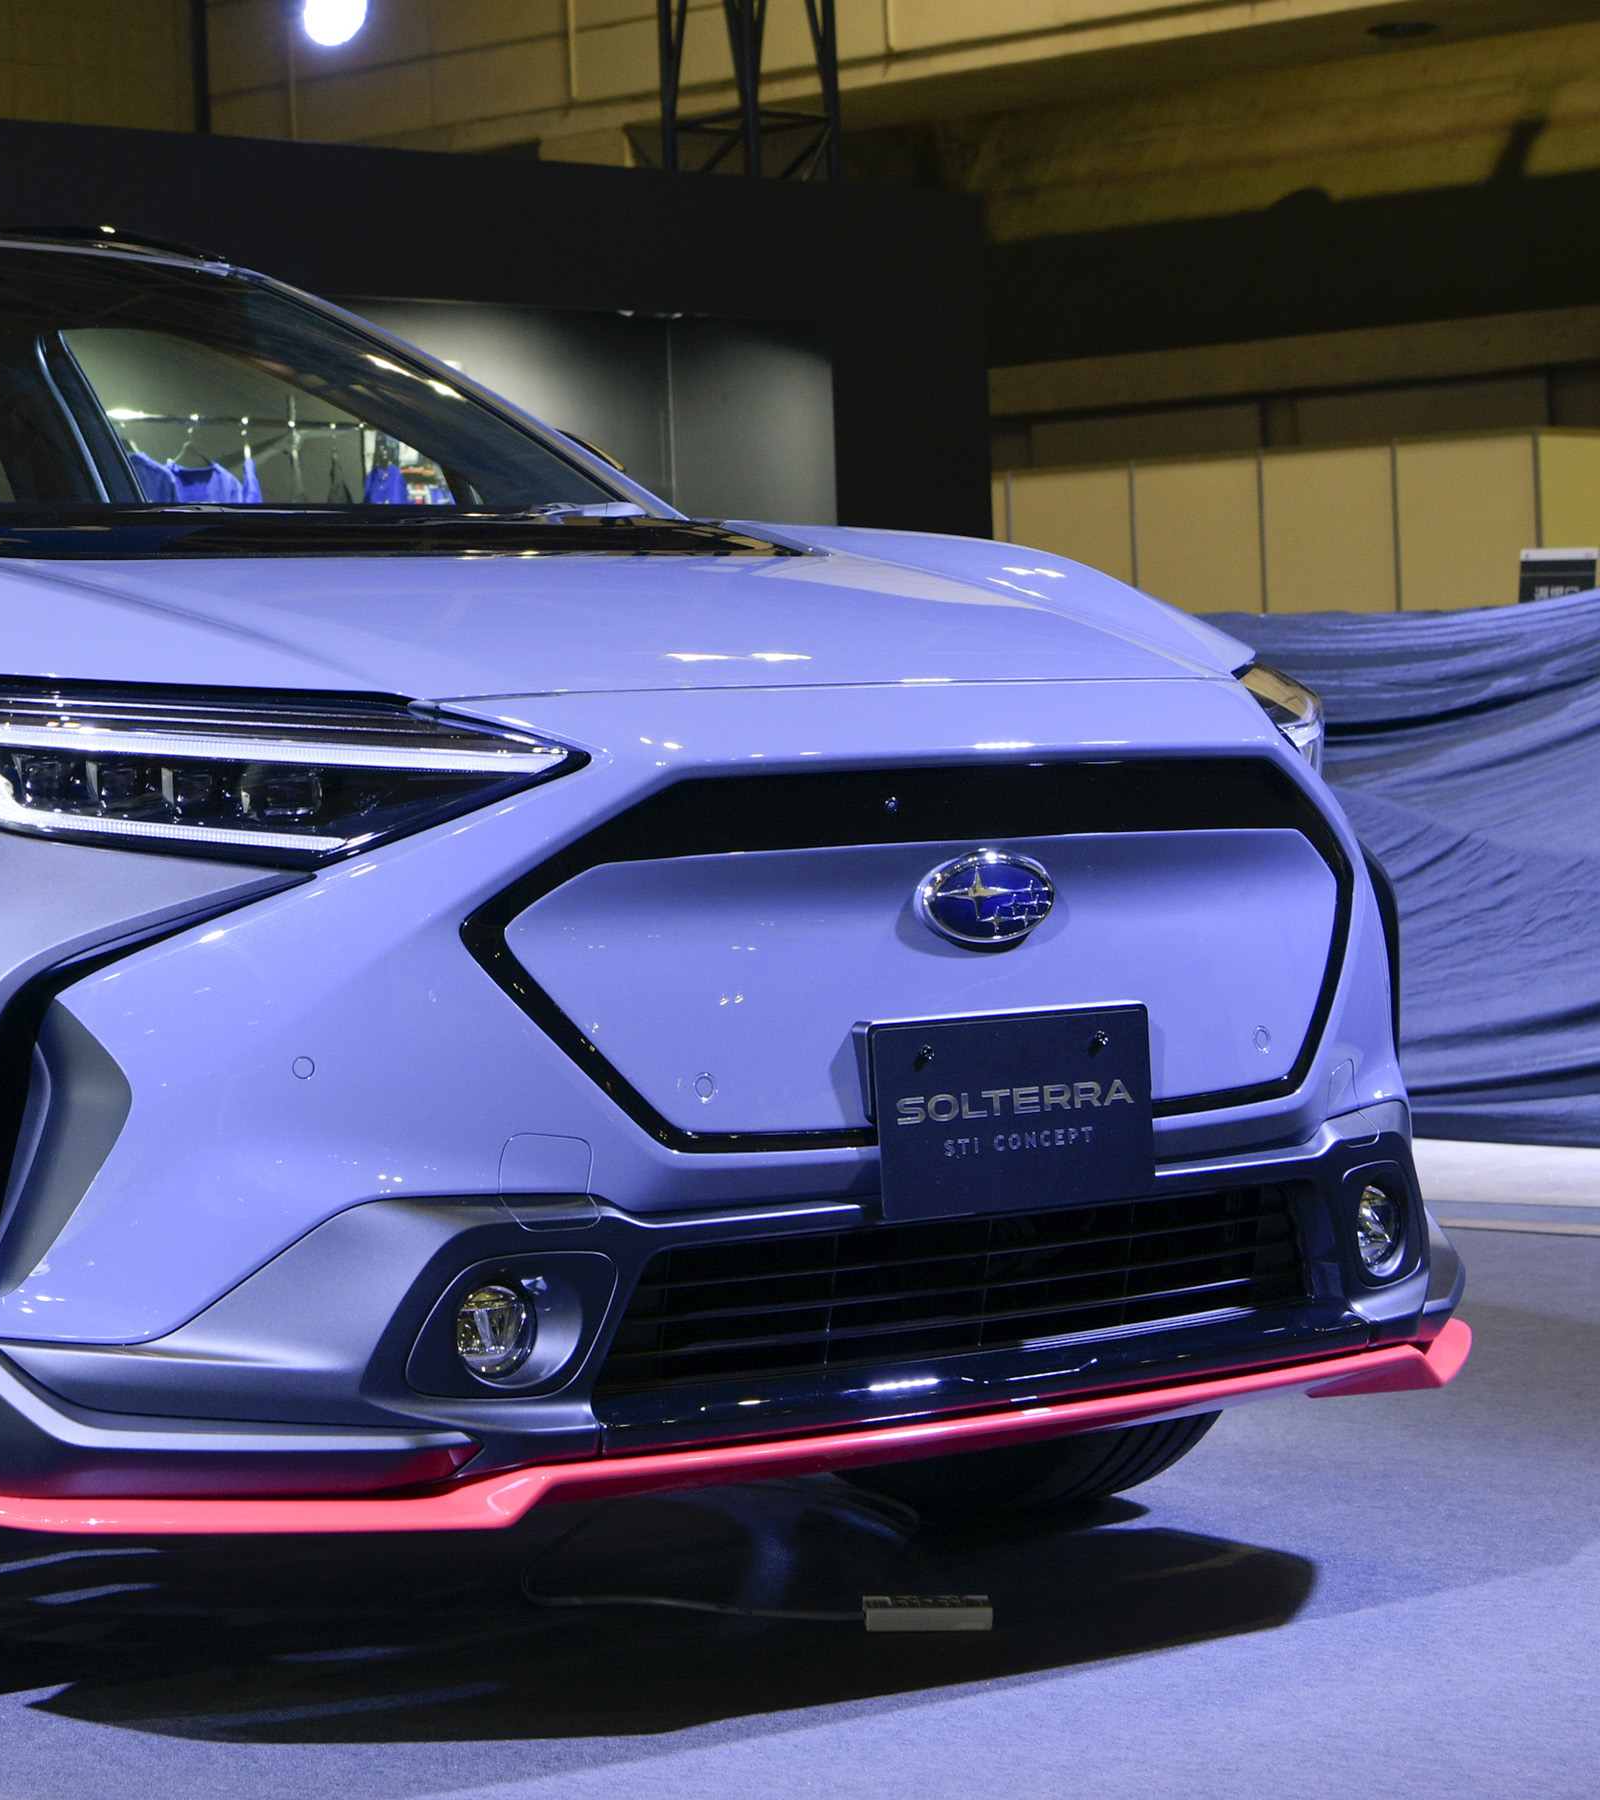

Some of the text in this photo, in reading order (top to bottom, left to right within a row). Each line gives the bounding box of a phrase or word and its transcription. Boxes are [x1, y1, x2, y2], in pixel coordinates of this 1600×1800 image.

[895, 1078, 1135, 1126] SOLTERRA
[943, 1126, 1094, 1157] STI CONCEPT
